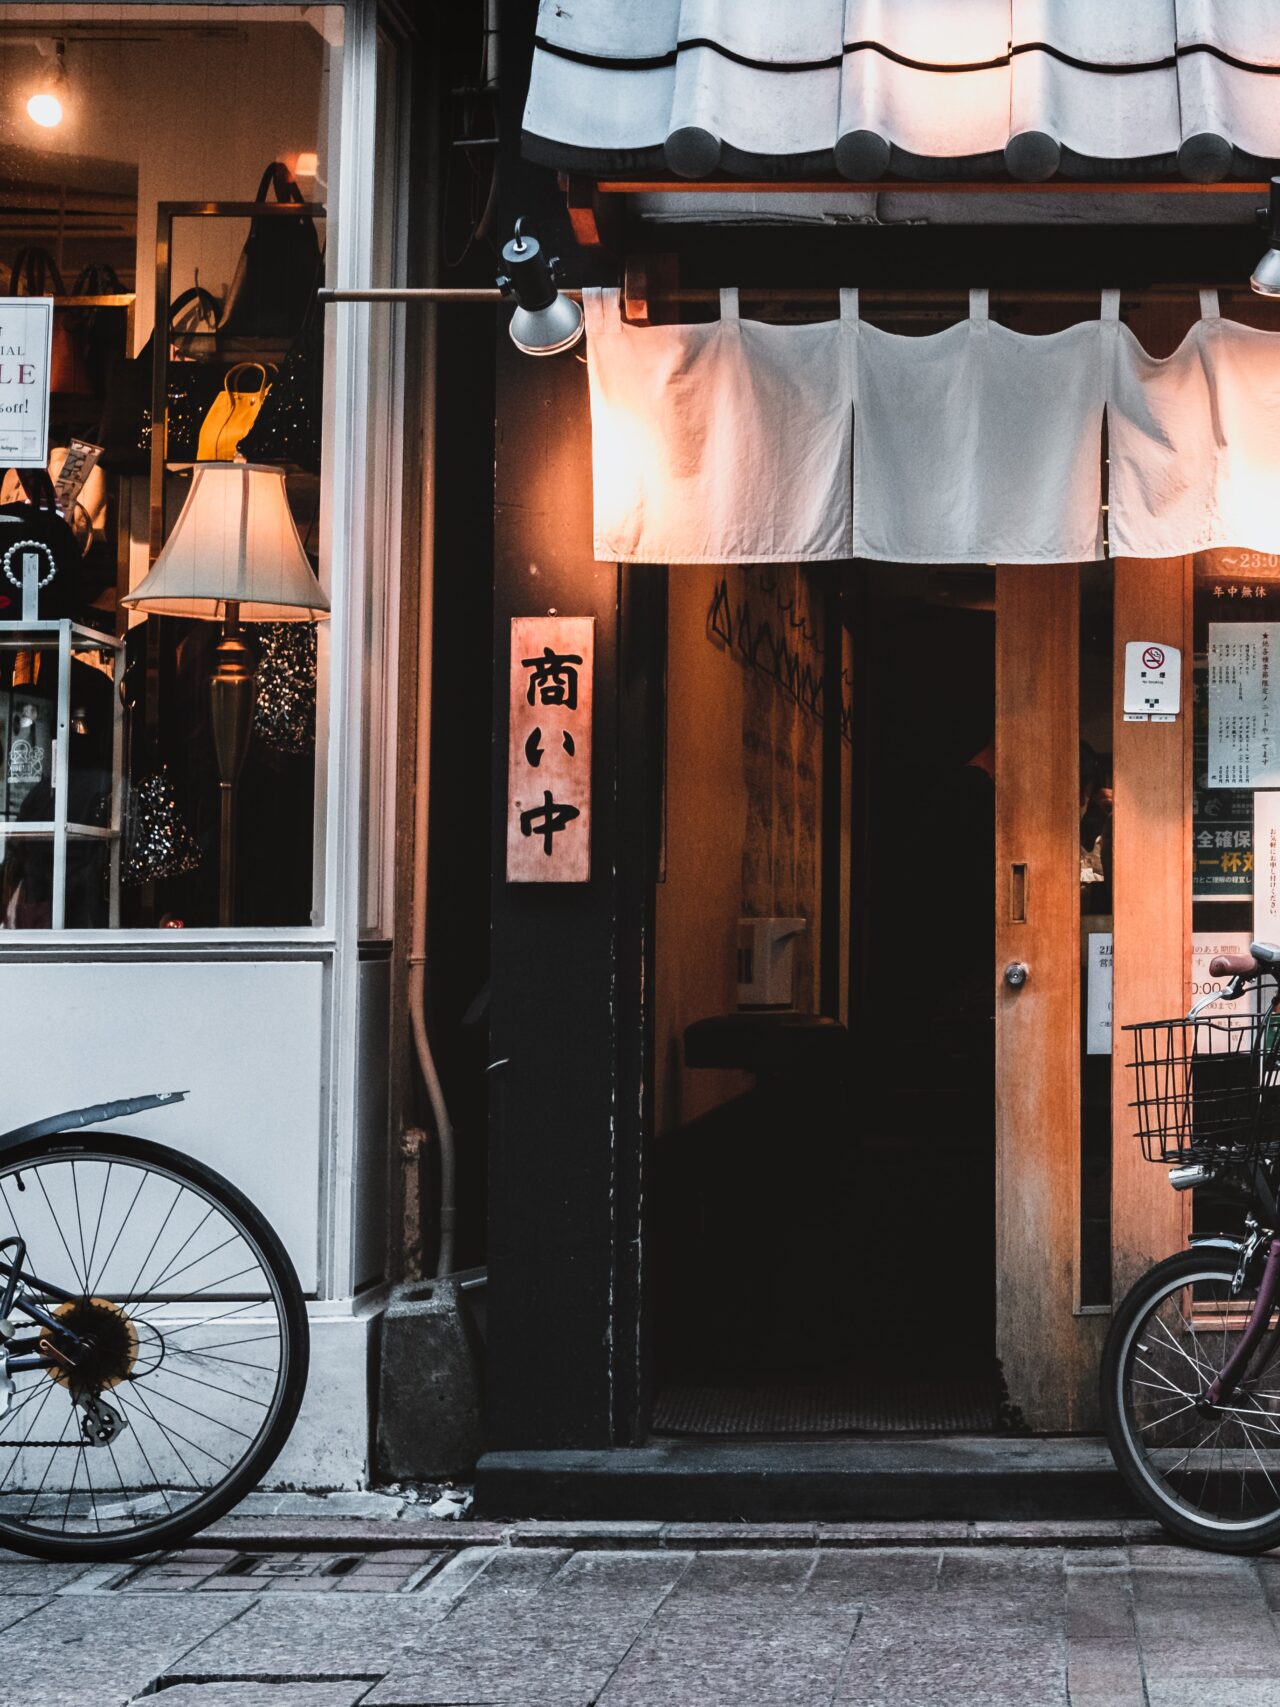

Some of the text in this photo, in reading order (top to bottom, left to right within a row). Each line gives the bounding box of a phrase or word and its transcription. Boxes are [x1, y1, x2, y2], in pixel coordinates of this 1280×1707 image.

[1213, 585, 1267, 599] 年中無休
[520, 647, 583, 856] 商い中
[1193, 830, 1251, 848] 全確保
